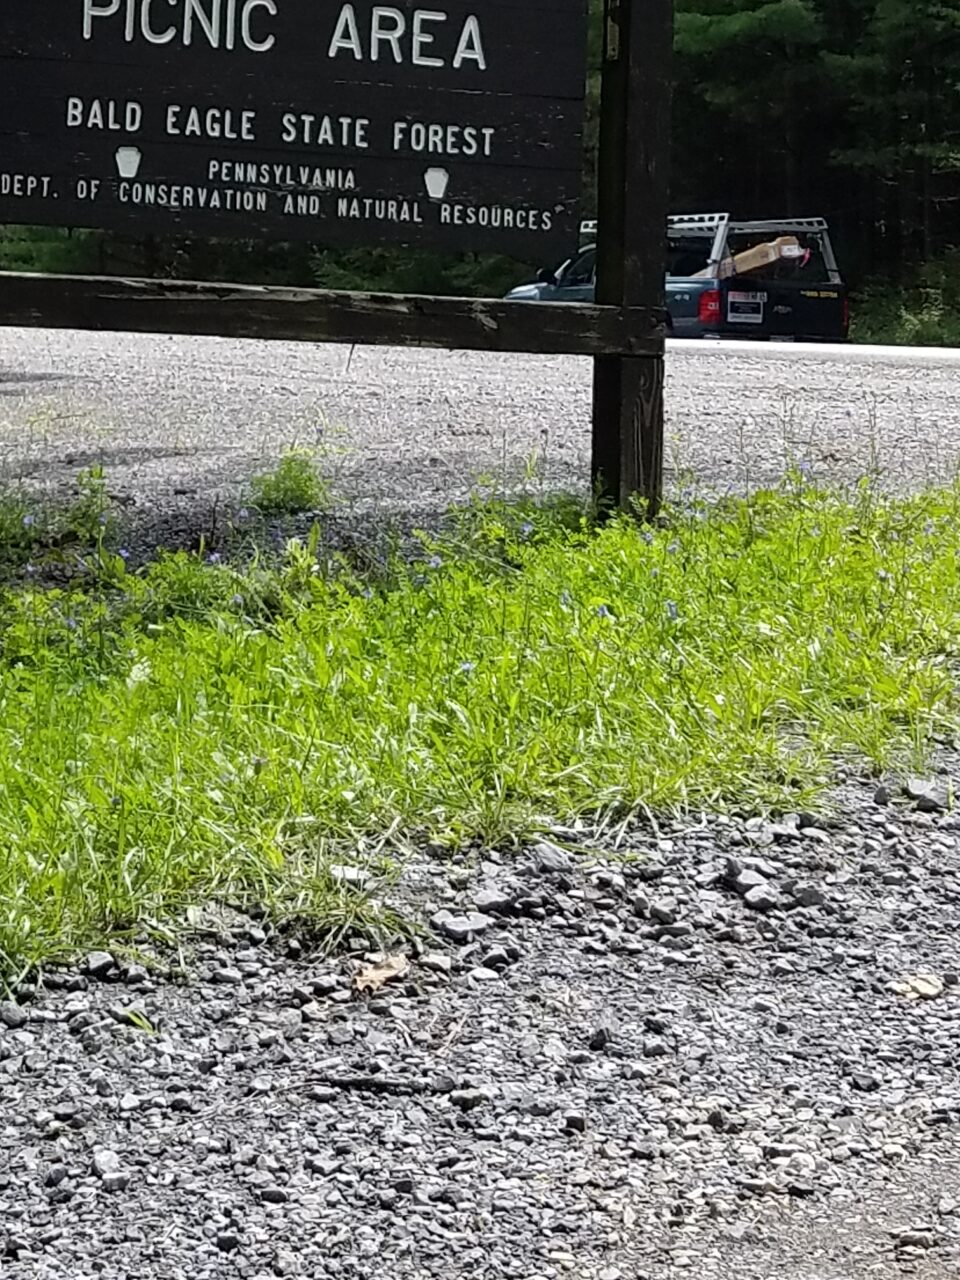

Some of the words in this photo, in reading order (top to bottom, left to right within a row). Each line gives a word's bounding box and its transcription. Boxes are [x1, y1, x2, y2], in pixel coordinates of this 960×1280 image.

[328, 3, 487, 70] AREA
[66, 97, 142, 132] BALD
[166, 105, 255, 140] EAGLE
[282, 113, 369, 148] STATE
[393, 122, 495, 156] FOREST
[1, 174, 58, 198] DEPT.
[77, 180, 100, 200] OF
[119, 182, 267, 211] CONSERVATION
[284, 194, 320, 215] AND
[337, 198, 423, 222] NATURAL
[440, 203, 552, 230] RESOURCES
[208, 160, 355, 189] PENNSYLVANIA
